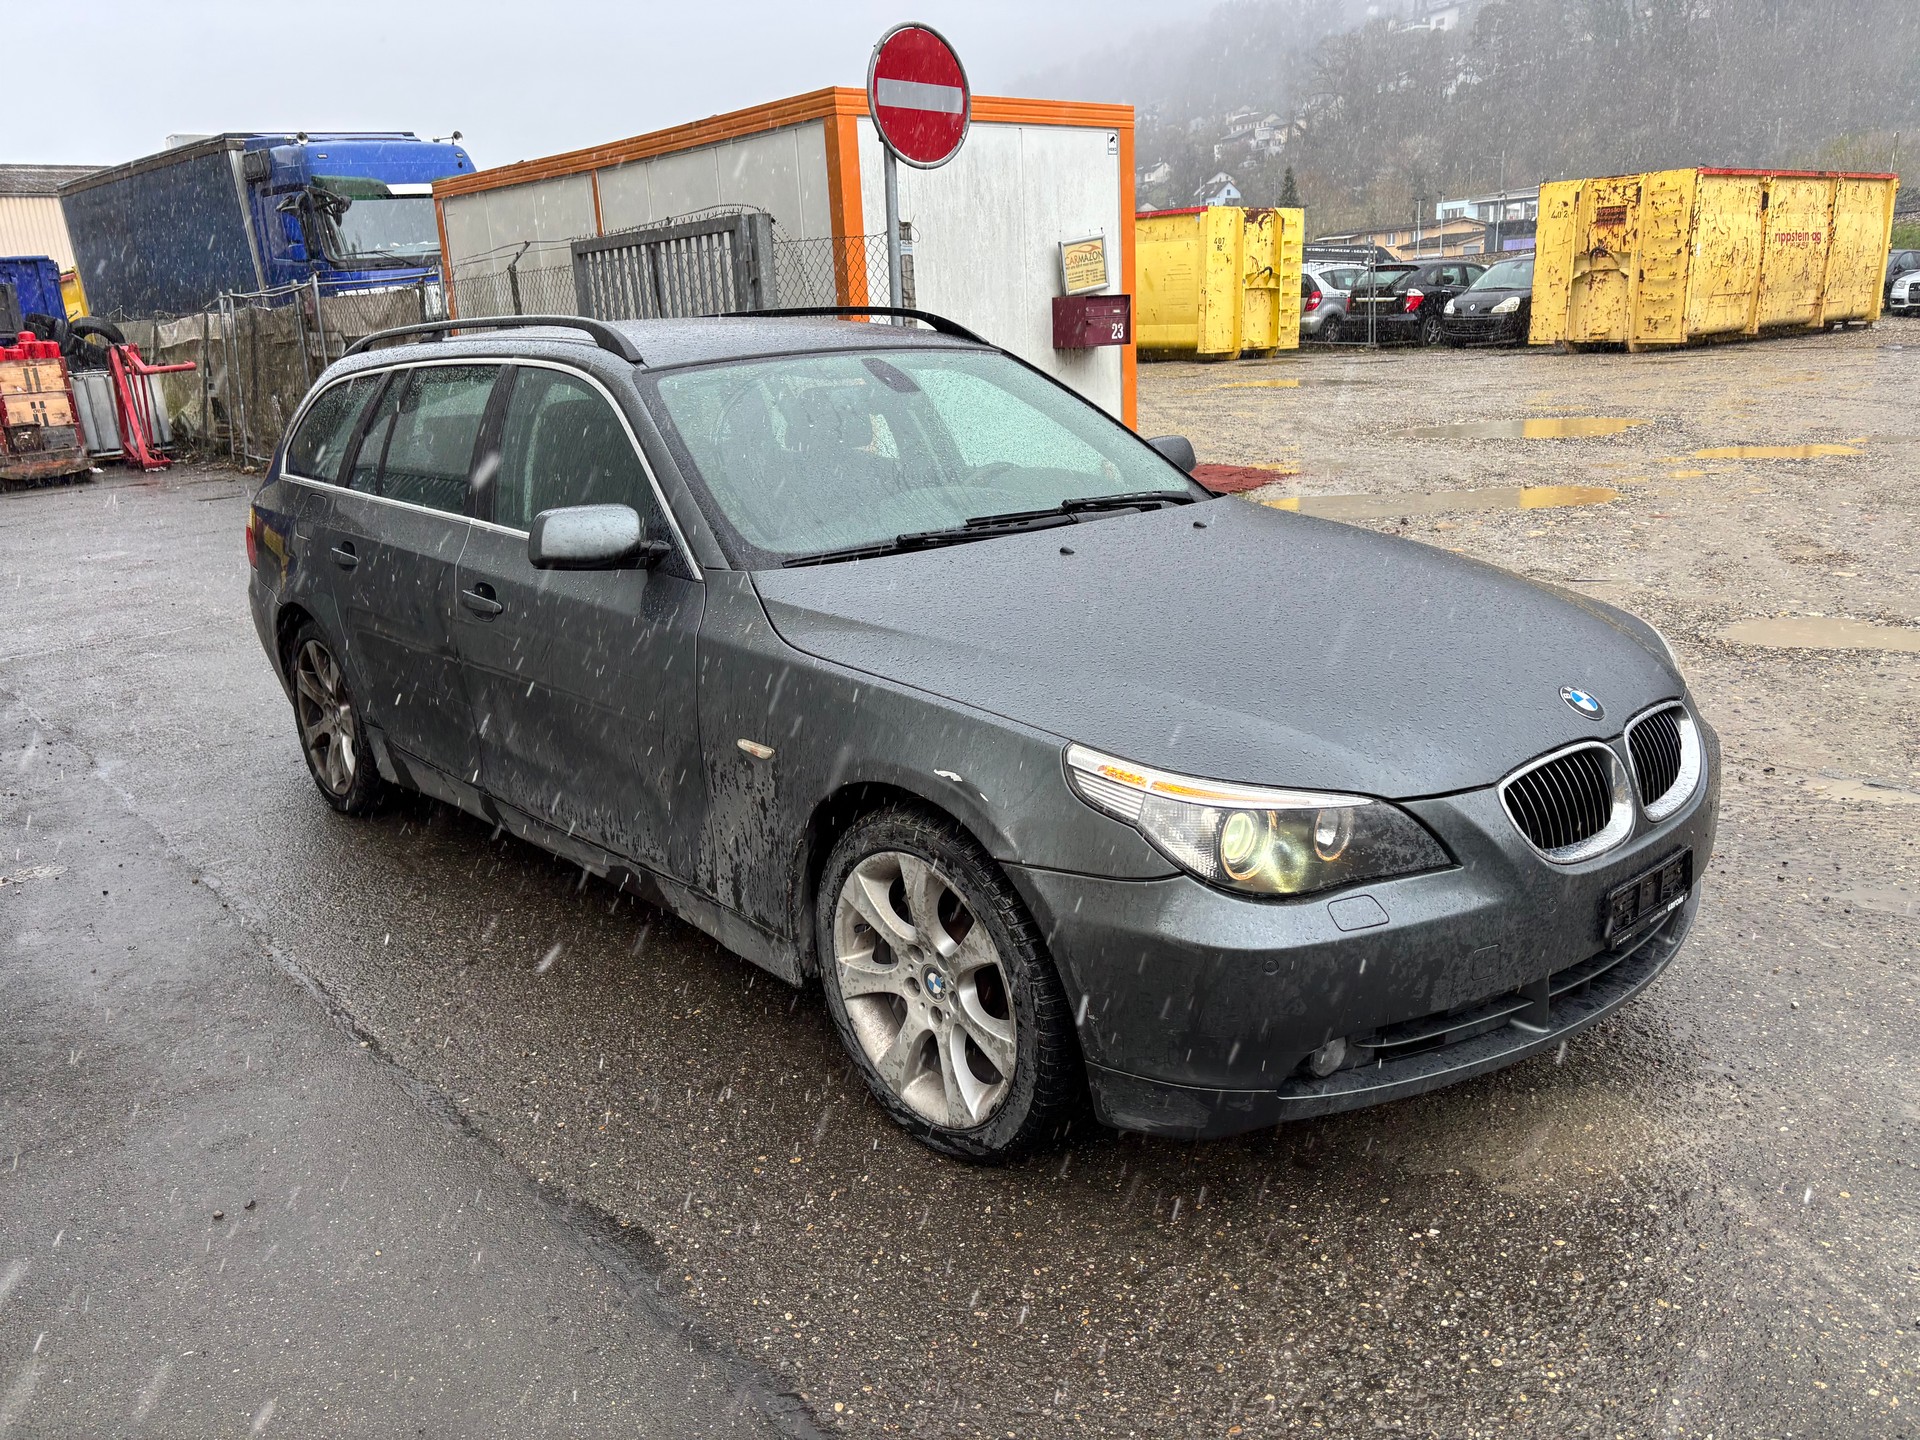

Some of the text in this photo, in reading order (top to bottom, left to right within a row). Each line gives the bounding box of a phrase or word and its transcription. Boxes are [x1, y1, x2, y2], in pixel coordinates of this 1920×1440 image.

[1551, 210, 1569, 219] 402
[1213, 237, 1225, 245] 407
[1774, 229, 1822, 246] rippstein ag
[1065, 250, 1104, 267] CARMAZON
[1111, 323, 1124, 340] 23
